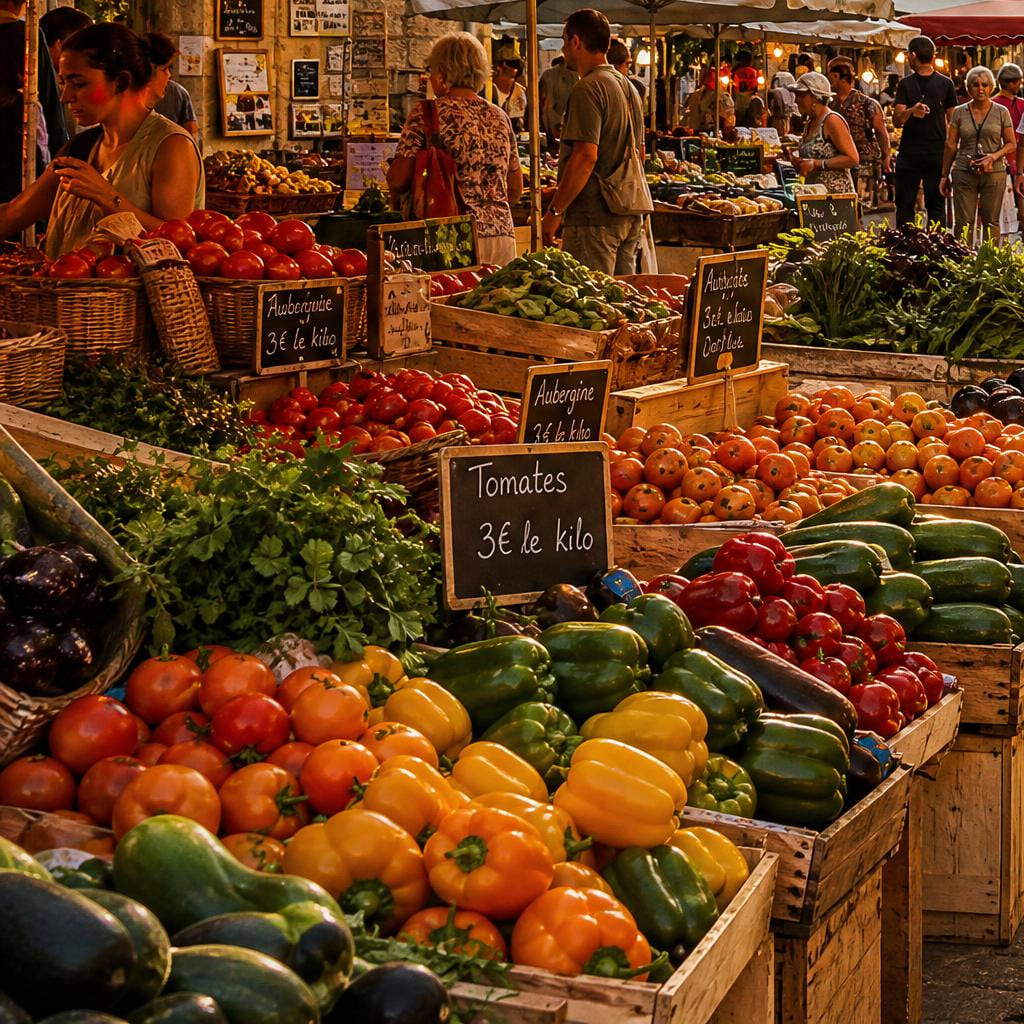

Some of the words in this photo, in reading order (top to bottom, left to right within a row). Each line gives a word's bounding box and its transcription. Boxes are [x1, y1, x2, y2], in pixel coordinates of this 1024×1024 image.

[293, 327, 306, 350] le
[533, 378, 595, 415] Aubergine
[467, 459, 568, 499] Tomates
[477, 521, 513, 559] 3€
[520, 519, 543, 554] le
[555, 516, 594, 552] kilo
